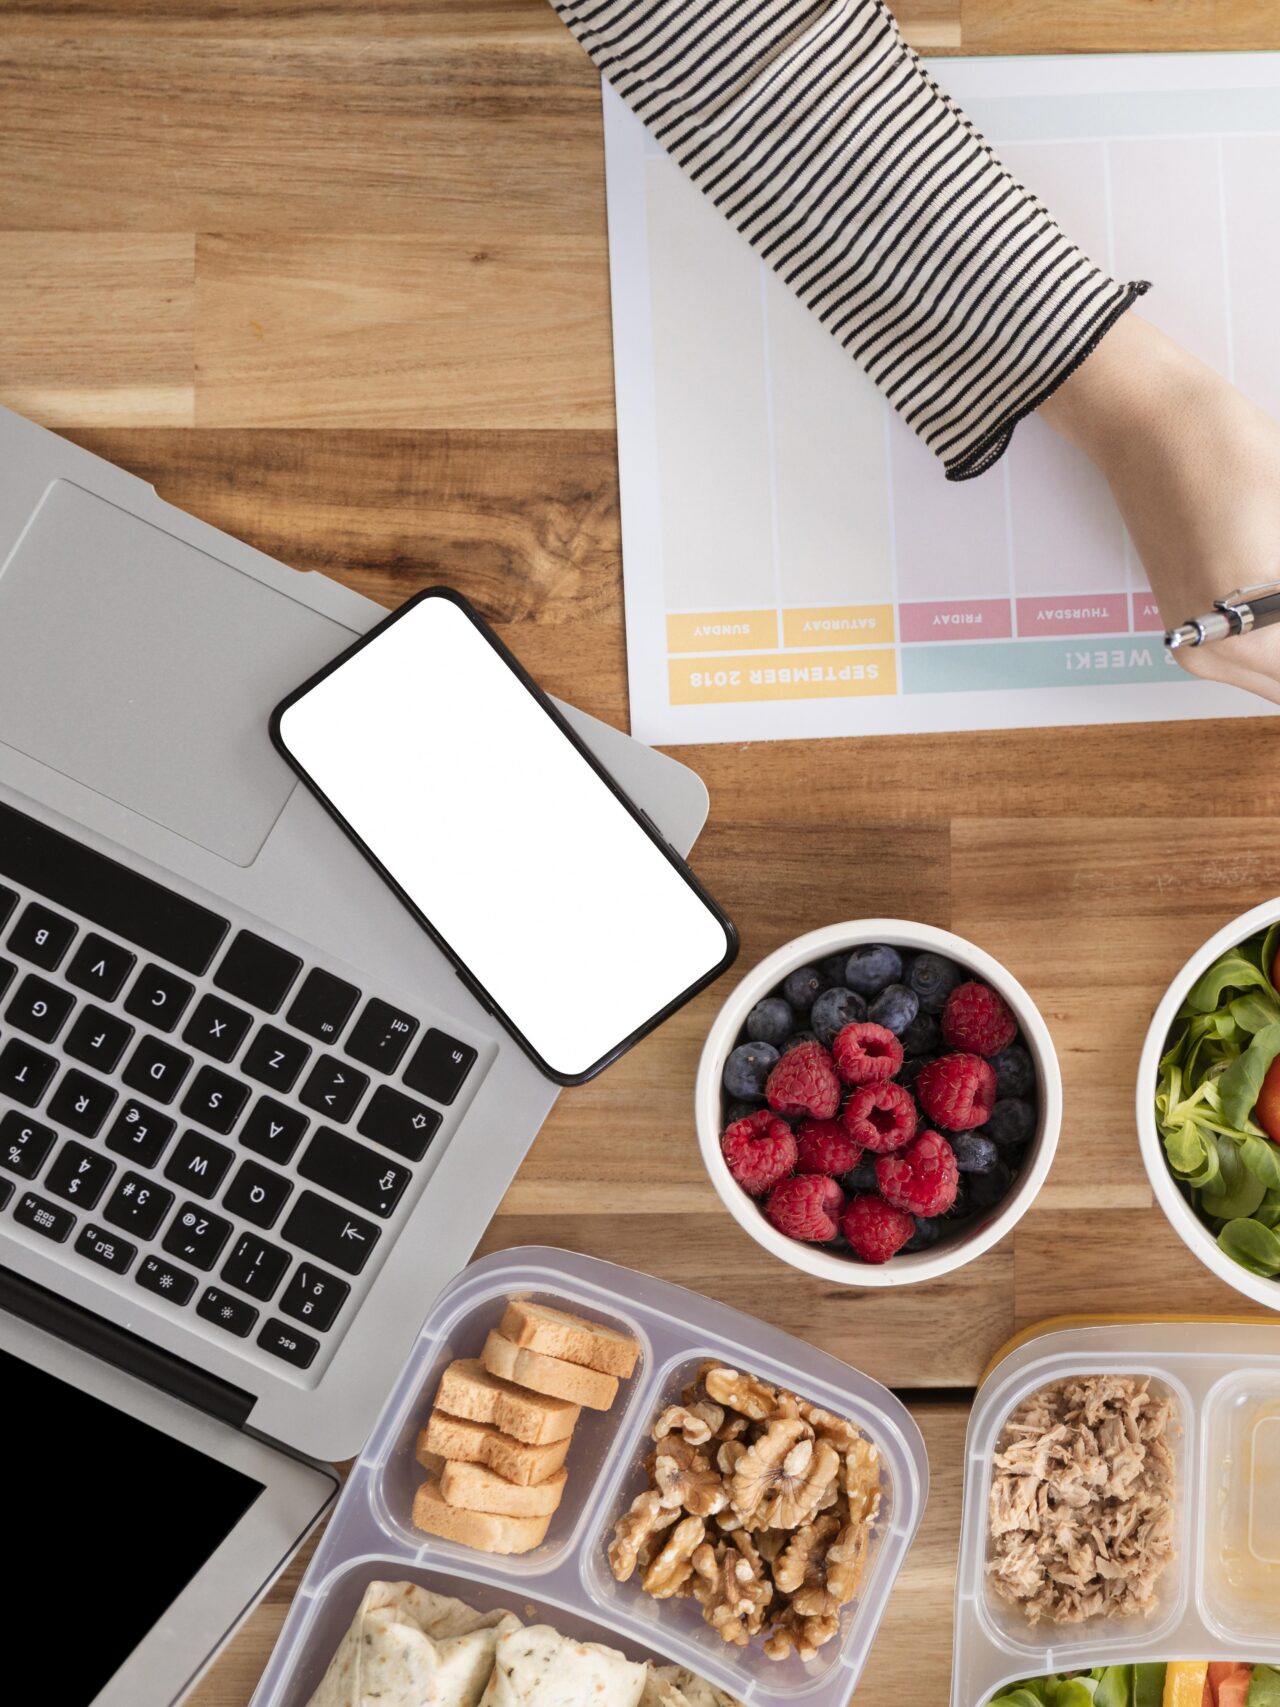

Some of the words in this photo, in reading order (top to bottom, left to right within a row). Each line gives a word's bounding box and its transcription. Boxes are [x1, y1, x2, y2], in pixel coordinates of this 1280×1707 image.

[932, 613, 982, 625] FRIDAY
[1036, 607, 1109, 620] THURSDAY
[693, 623, 750, 637] SUNDAY
[803, 617, 876, 631] SATURDAY
[1065, 648, 1152, 670] WEEK!
[689, 670, 741, 688] 2018
[748, 663, 879, 685] SEPTEMBER
[36, 930, 48, 945] B
[92, 961, 104, 976] V
[152, 991, 166, 1005] C
[32, 1002, 47, 1016] G
[210, 1020, 226, 1037] X
[391, 1020, 408, 1032] ctrl
[91, 1034, 105, 1047] F
[269, 1051, 284, 1067] Z
[452, 1051, 462, 1063] fn
[16, 1067, 27, 1081] T
[151, 1063, 165, 1079] D
[75, 1096, 89, 1112] R
[209, 1093, 222, 1107] S
[126, 1109, 139, 1122] €
[19, 1129, 32, 1143] 5
[134, 1127, 147, 1142] E
[270, 1122, 283, 1138] A
[9, 1147, 21, 1162] %
[79, 1160, 90, 1172] 4
[189, 1157, 207, 1175] W
[69, 1179, 80, 1192] $
[138, 1190, 149, 1204] 3
[251, 1186, 264, 1202] Q
[196, 1220, 208, 1234] 2
[86, 1230, 97, 1240] F3
[148, 1262, 157, 1270] F2
[279, 1337, 296, 1349] esc
